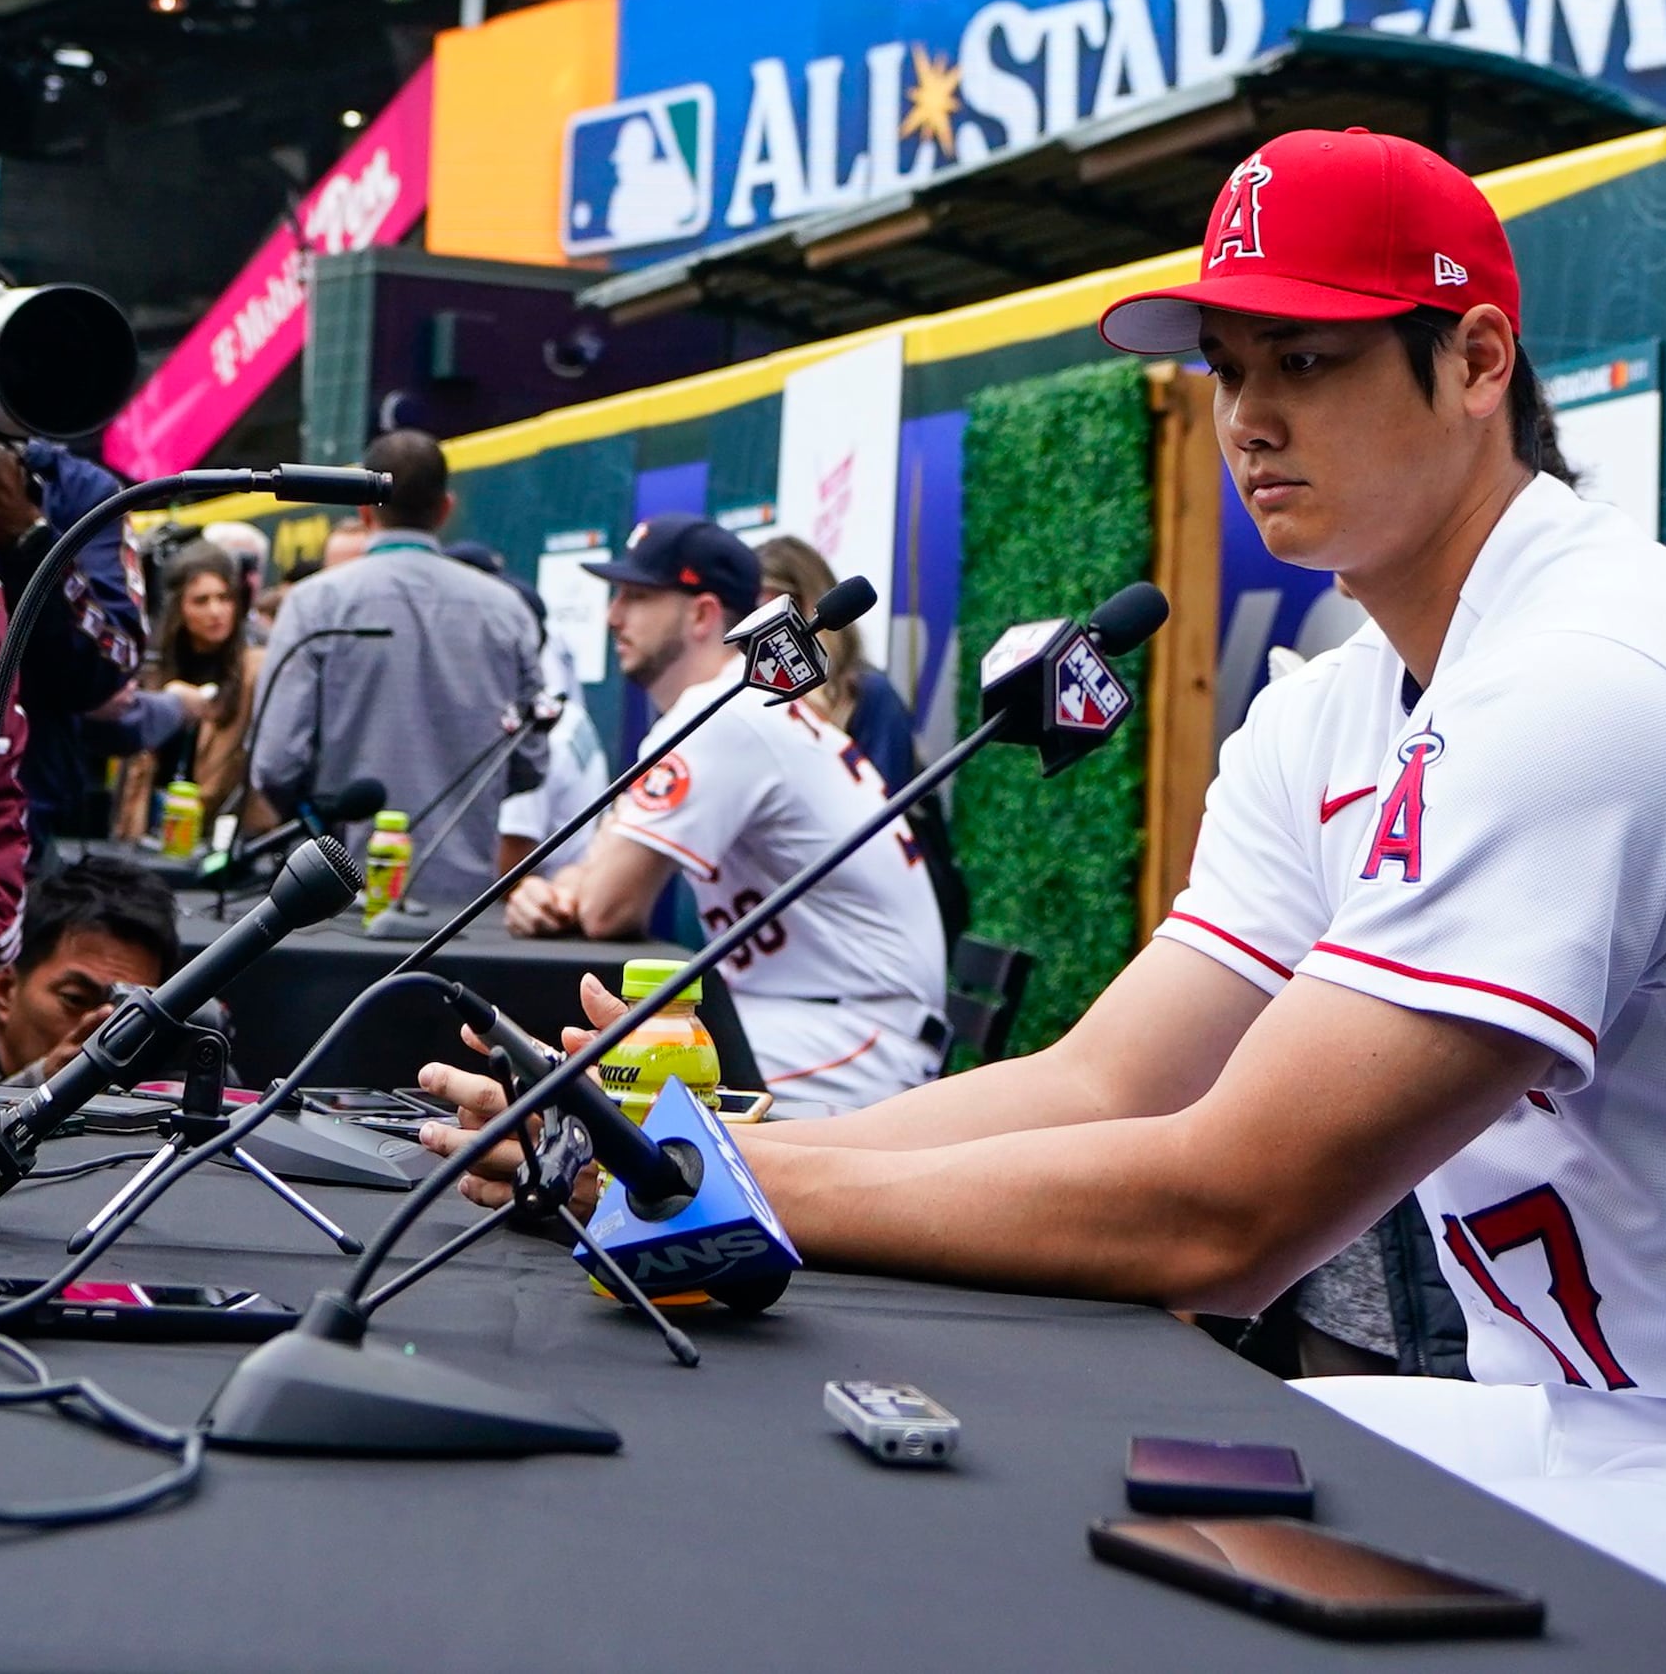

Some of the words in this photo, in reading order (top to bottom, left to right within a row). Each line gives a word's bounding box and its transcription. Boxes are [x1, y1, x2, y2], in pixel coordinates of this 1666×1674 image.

[731, 44, 933, 228] ALL
[766, 639, 798, 686] NETWORK
[774, 630, 808, 683] MLB
[1070, 646, 1123, 716] MLB
[635, 1227, 770, 1278] SNY
[1443, 1183, 1638, 1391] 17
